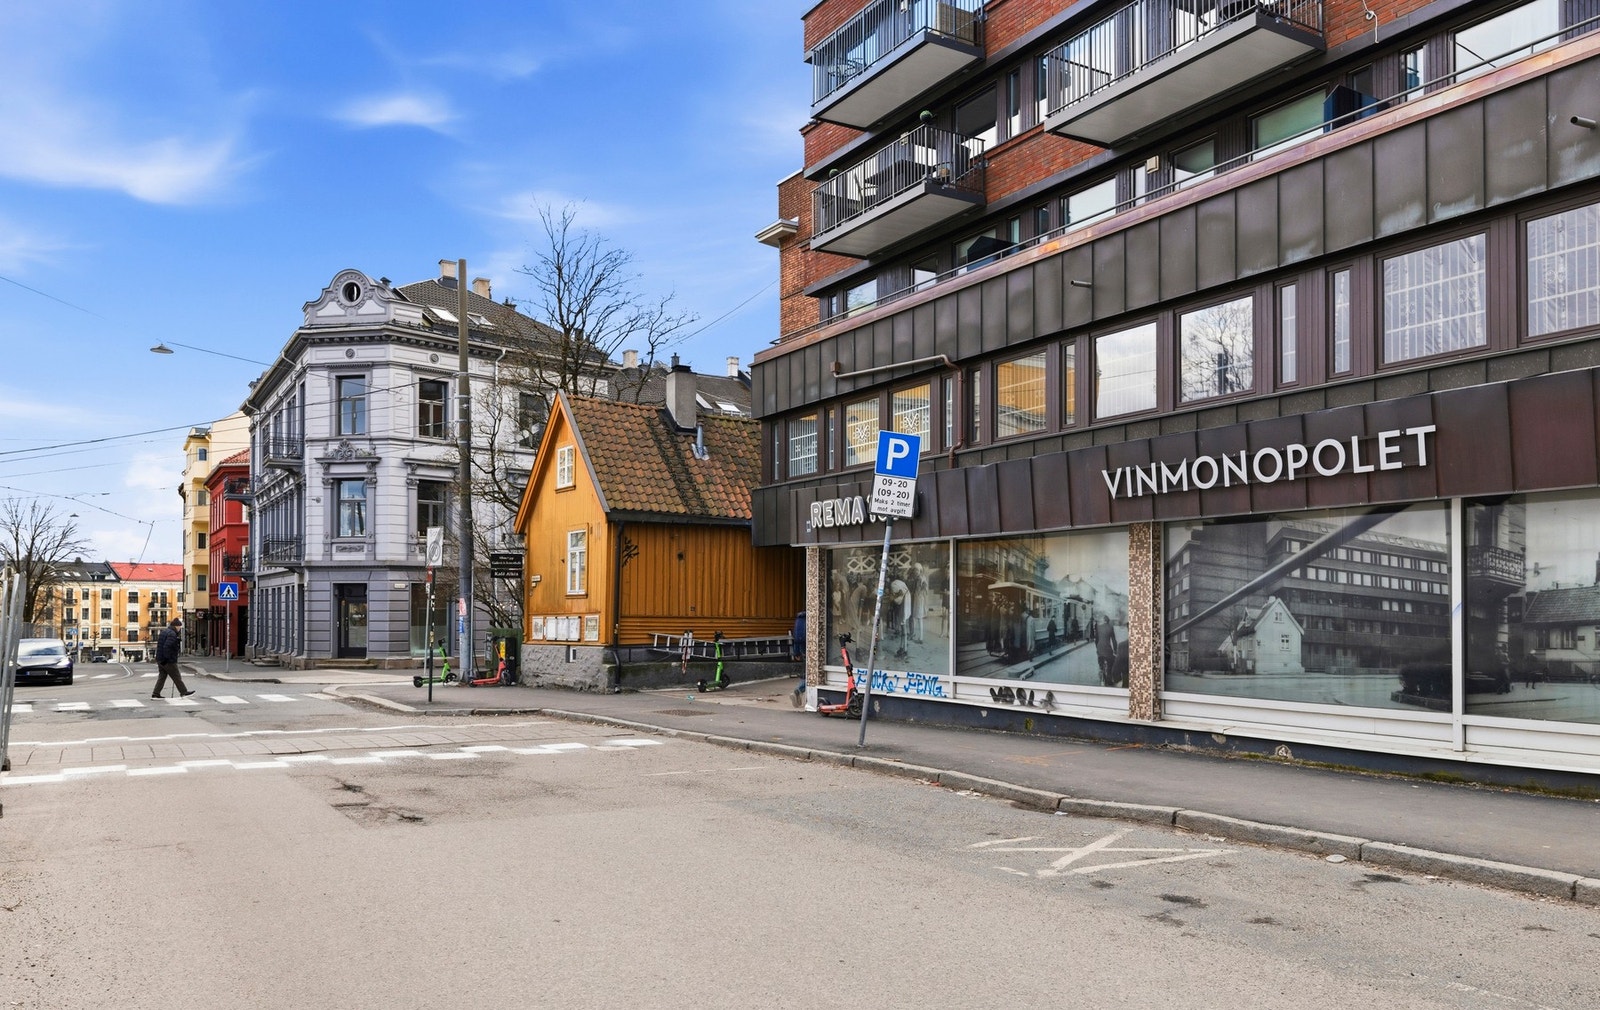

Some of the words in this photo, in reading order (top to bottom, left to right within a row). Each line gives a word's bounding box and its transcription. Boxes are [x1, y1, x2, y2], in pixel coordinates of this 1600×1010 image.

[886, 437, 910, 471] P
[1101, 424, 1437, 500] VINMONOPOLET
[810, 496, 865, 528] REMA
[874, 497, 888, 505] Maks
[896, 500, 911, 508] timer
[890, 507, 906, 515] avgift
